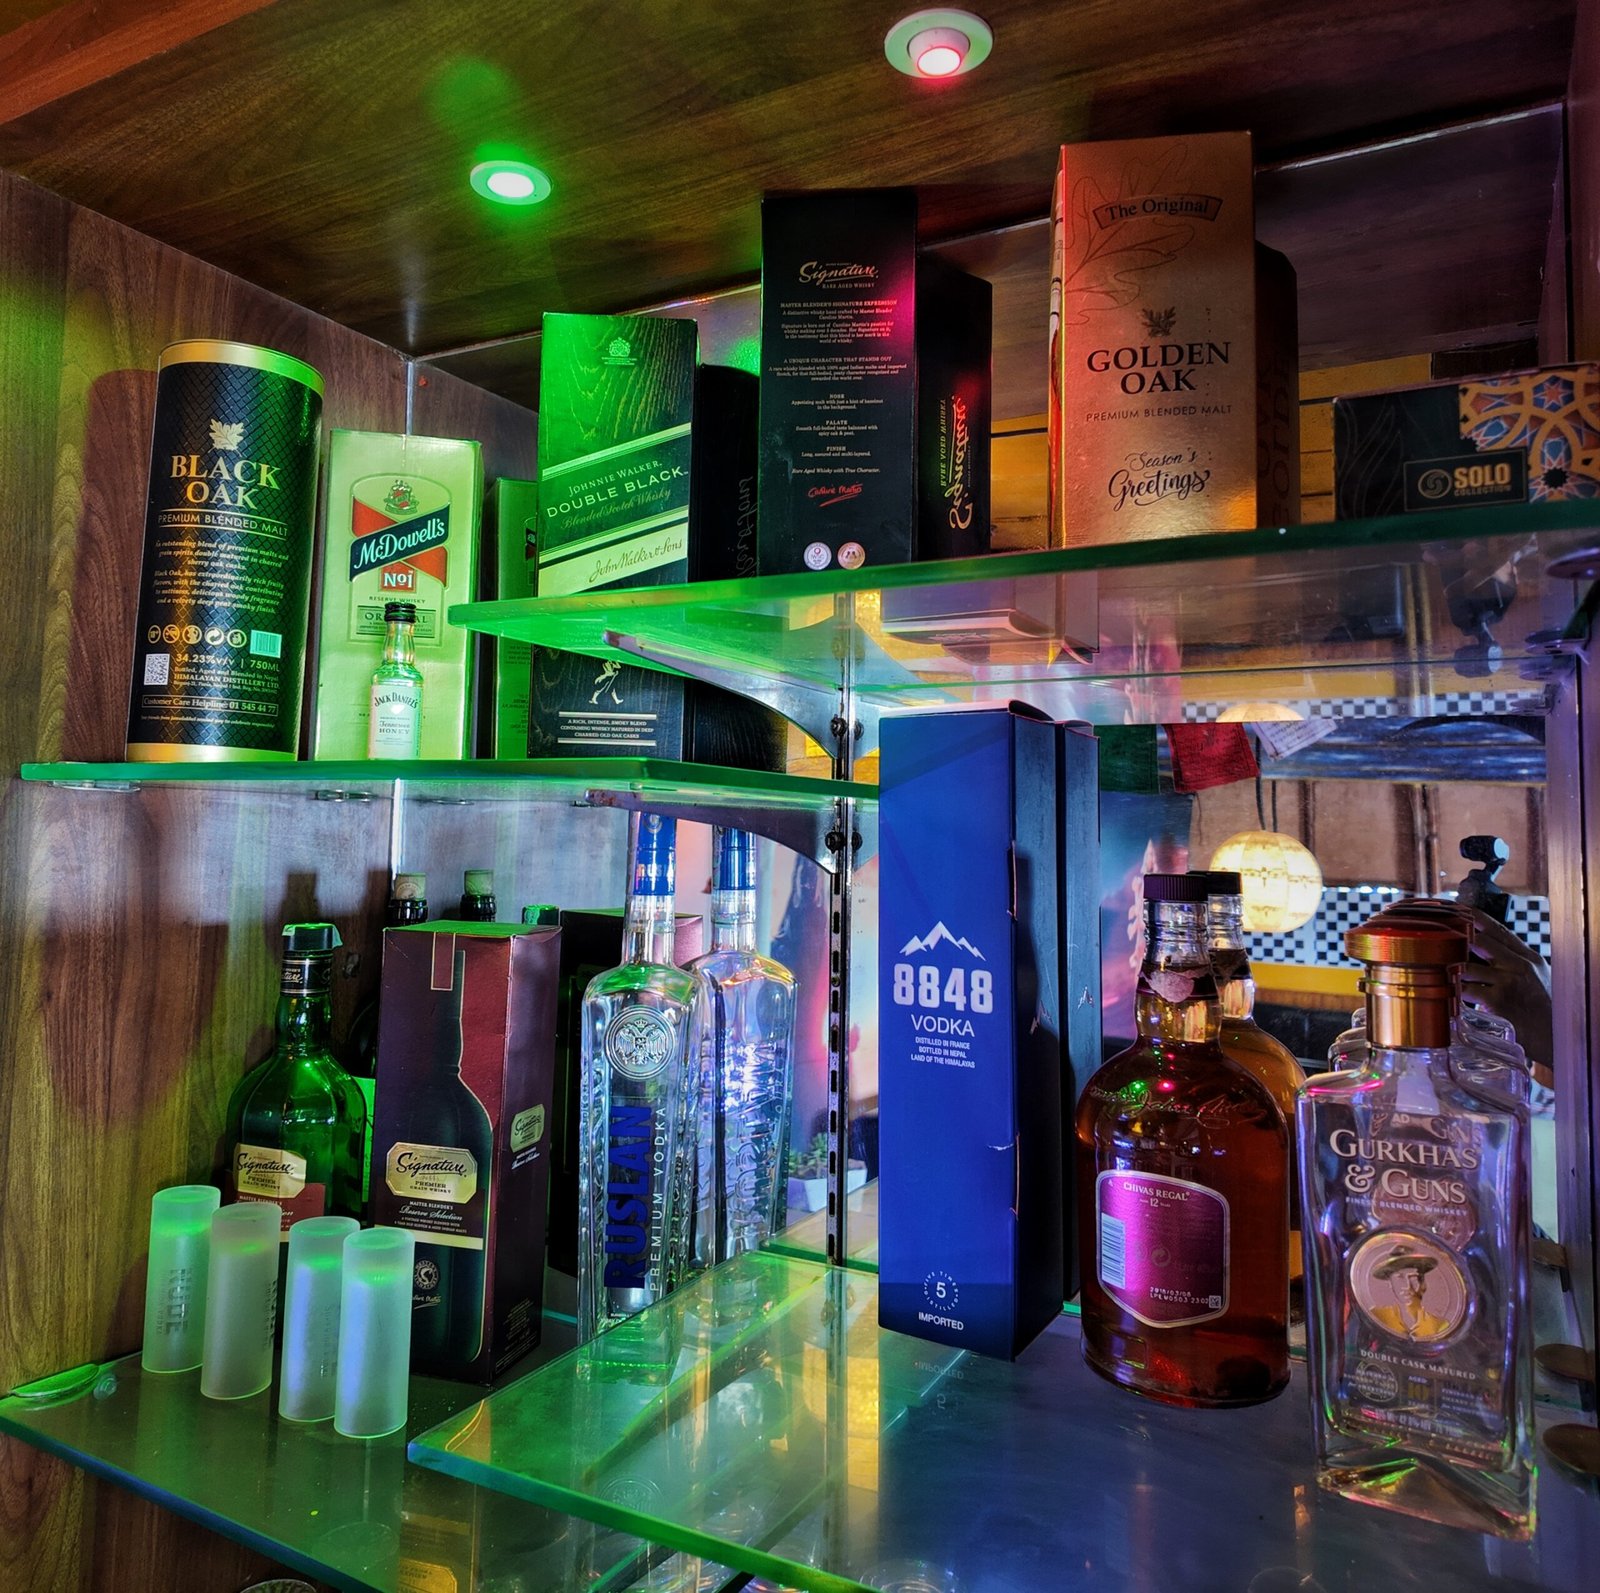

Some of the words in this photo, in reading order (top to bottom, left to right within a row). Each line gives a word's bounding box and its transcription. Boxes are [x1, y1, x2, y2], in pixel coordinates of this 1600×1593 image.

[1105, 203, 1138, 221] The
[1142, 197, 1210, 216] Original
[798, 260, 879, 286] Signature
[1087, 341, 1232, 373] GOLDEN
[1120, 368, 1197, 395] OAK
[1086, 408, 1140, 422] PREMIUM
[1144, 405, 1197, 418] BLENDED
[1200, 404, 1232, 416] MALT
[170, 454, 281, 491] BLACK
[1453, 462, 1511, 489] SOLO
[185, 480, 258, 511] OAK
[568, 473, 616, 498] JOHNNIE
[633, 488, 671, 507] Whisky
[1108, 468, 1211, 512] Greetings
[1453, 484, 1512, 497] COLLECTION
[546, 486, 619, 518] DOUBLE
[157, 513, 200, 524] PREMIUM
[204, 513, 258, 530] BLENDED
[261, 522, 288, 537] MALT
[353, 517, 445, 569] McDowell's
[249, 659, 281, 672] 750ML
[173, 673, 220, 683] HIMALAYAN
[222, 676, 266, 687] DISTILLERY
[143, 697, 173, 706] Customer
[172, 698, 191, 706] Care
[228, 701, 240, 710] 01
[240, 702, 256, 712] 545
[374, 694, 392, 708] JACK
[893, 963, 994, 1015] 8848
[910, 1013, 976, 1038] VODKA
[914, 1036, 942, 1046] DISTILLED
[942, 1039, 949, 1047] IN
[949, 1040, 971, 1050] FRANCE
[918, 1046, 943, 1055] BOTTLED
[949, 1049, 967, 1059] NEPAL
[910, 1053, 926, 1062] LAND
[925, 1055, 934, 1063] OF
[933, 1056, 945, 1065] THE
[944, 1058, 976, 1069] HIMALAYAS
[653, 1105, 667, 1178] VODKA
[1329, 1128, 1478, 1171] GURKHAS
[236, 1152, 295, 1176] Signature
[395, 1151, 468, 1178] Signature
[414, 1180, 447, 1189] PREMIER
[1123, 1181, 1154, 1196] CHIVAS
[1155, 1188, 1188, 1201] REGAL
[1344, 1163, 1376, 1194] &
[1381, 1167, 1467, 1205] GUNS
[409, 1200, 428, 1208] MASTER
[603, 1105, 651, 1290] RUSLAN
[1149, 1197, 1159, 1208] 12
[1380, 1200, 1422, 1213] BLENDED
[1424, 1205, 1469, 1217] WHISKEY
[399, 1204, 429, 1217] Reserve
[429, 1208, 463, 1221] Selection
[649, 1190, 665, 1293] PREMIUM
[935, 1281, 947, 1299] 5
[918, 1311, 965, 1331] IMPORTED
[1360, 1349, 1399, 1365] DOUBLE
[1400, 1357, 1427, 1371] CASK
[1428, 1363, 1477, 1381] MATURED
